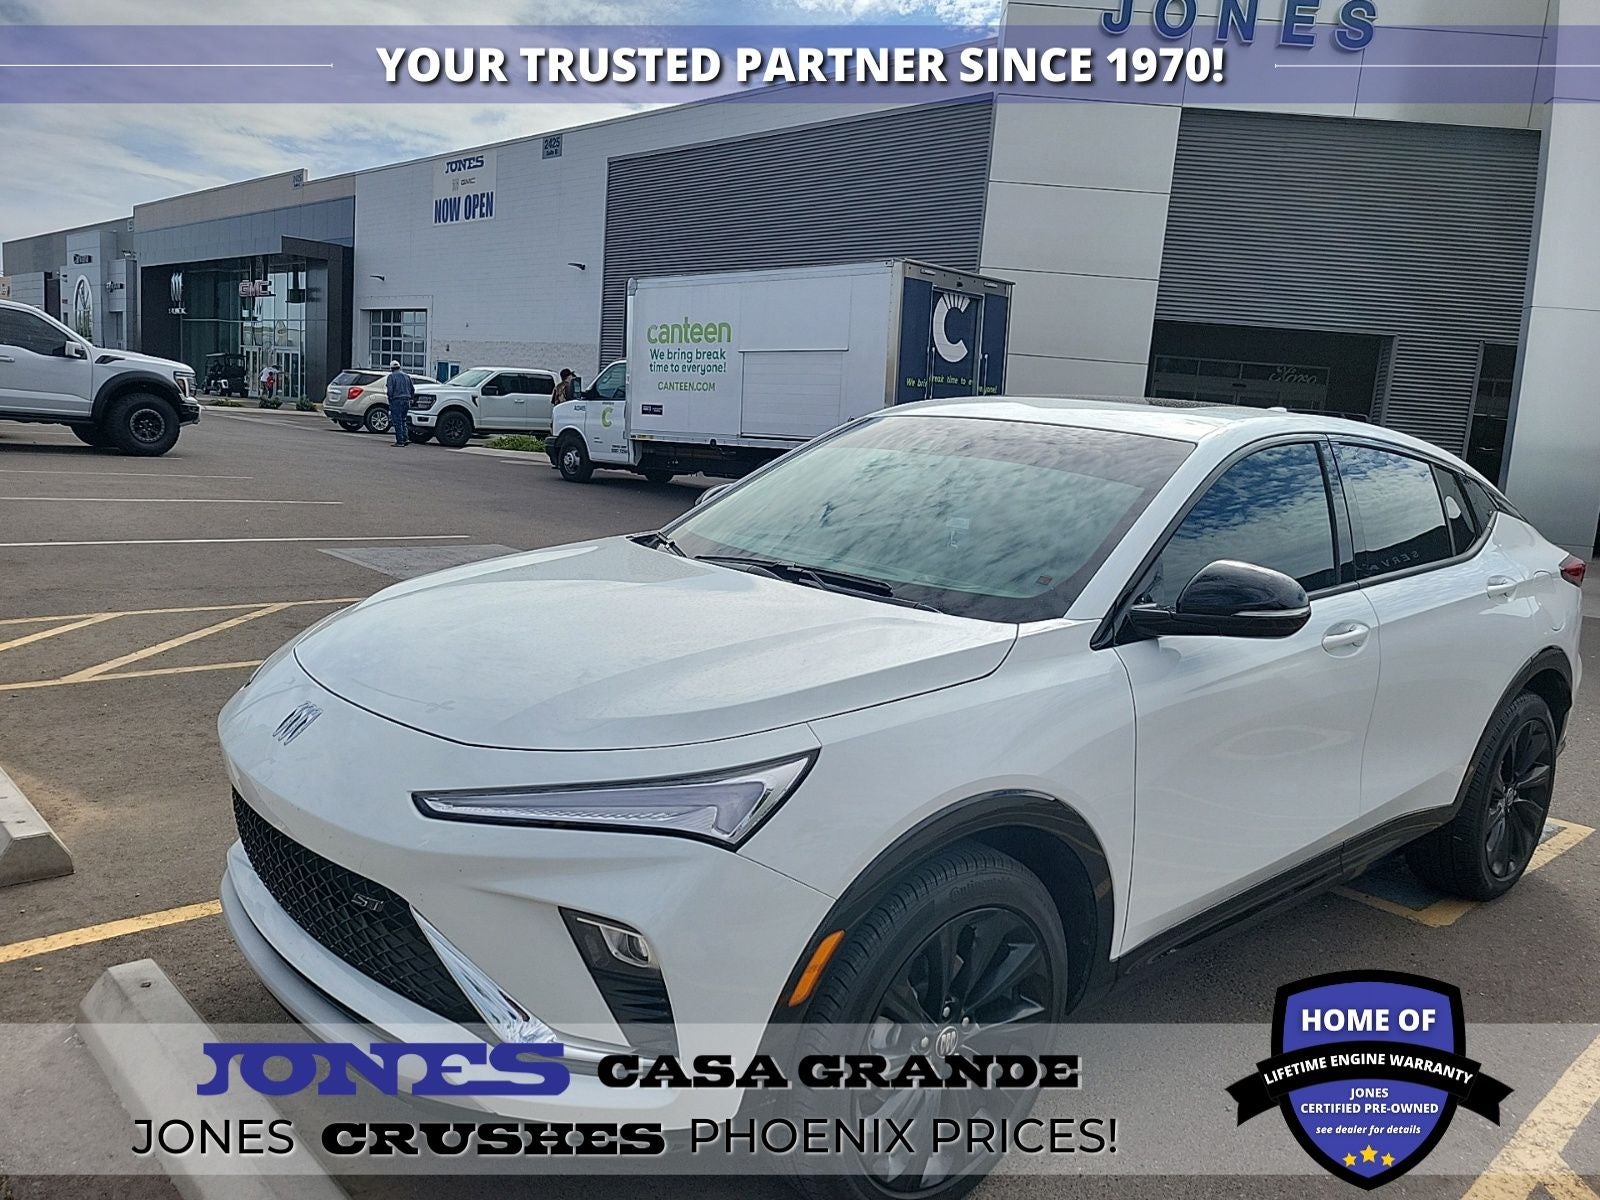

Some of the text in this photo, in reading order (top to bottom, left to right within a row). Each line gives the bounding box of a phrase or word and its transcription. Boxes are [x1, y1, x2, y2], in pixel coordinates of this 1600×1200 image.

[1100, 0, 1378, 51] JONES
[544, 137, 561, 149] 2425
[445, 155, 485, 174] JONES
[434, 191, 494, 224] NOW OPEN
[239, 280, 270, 298] GMC
[647, 316, 732, 344] canteen
[649, 348, 727, 363] We bring break
[649, 361, 727, 376] time to everyone!
[657, 381, 716, 392] CANTEEN.COM
[351, 893, 385, 913] ST
